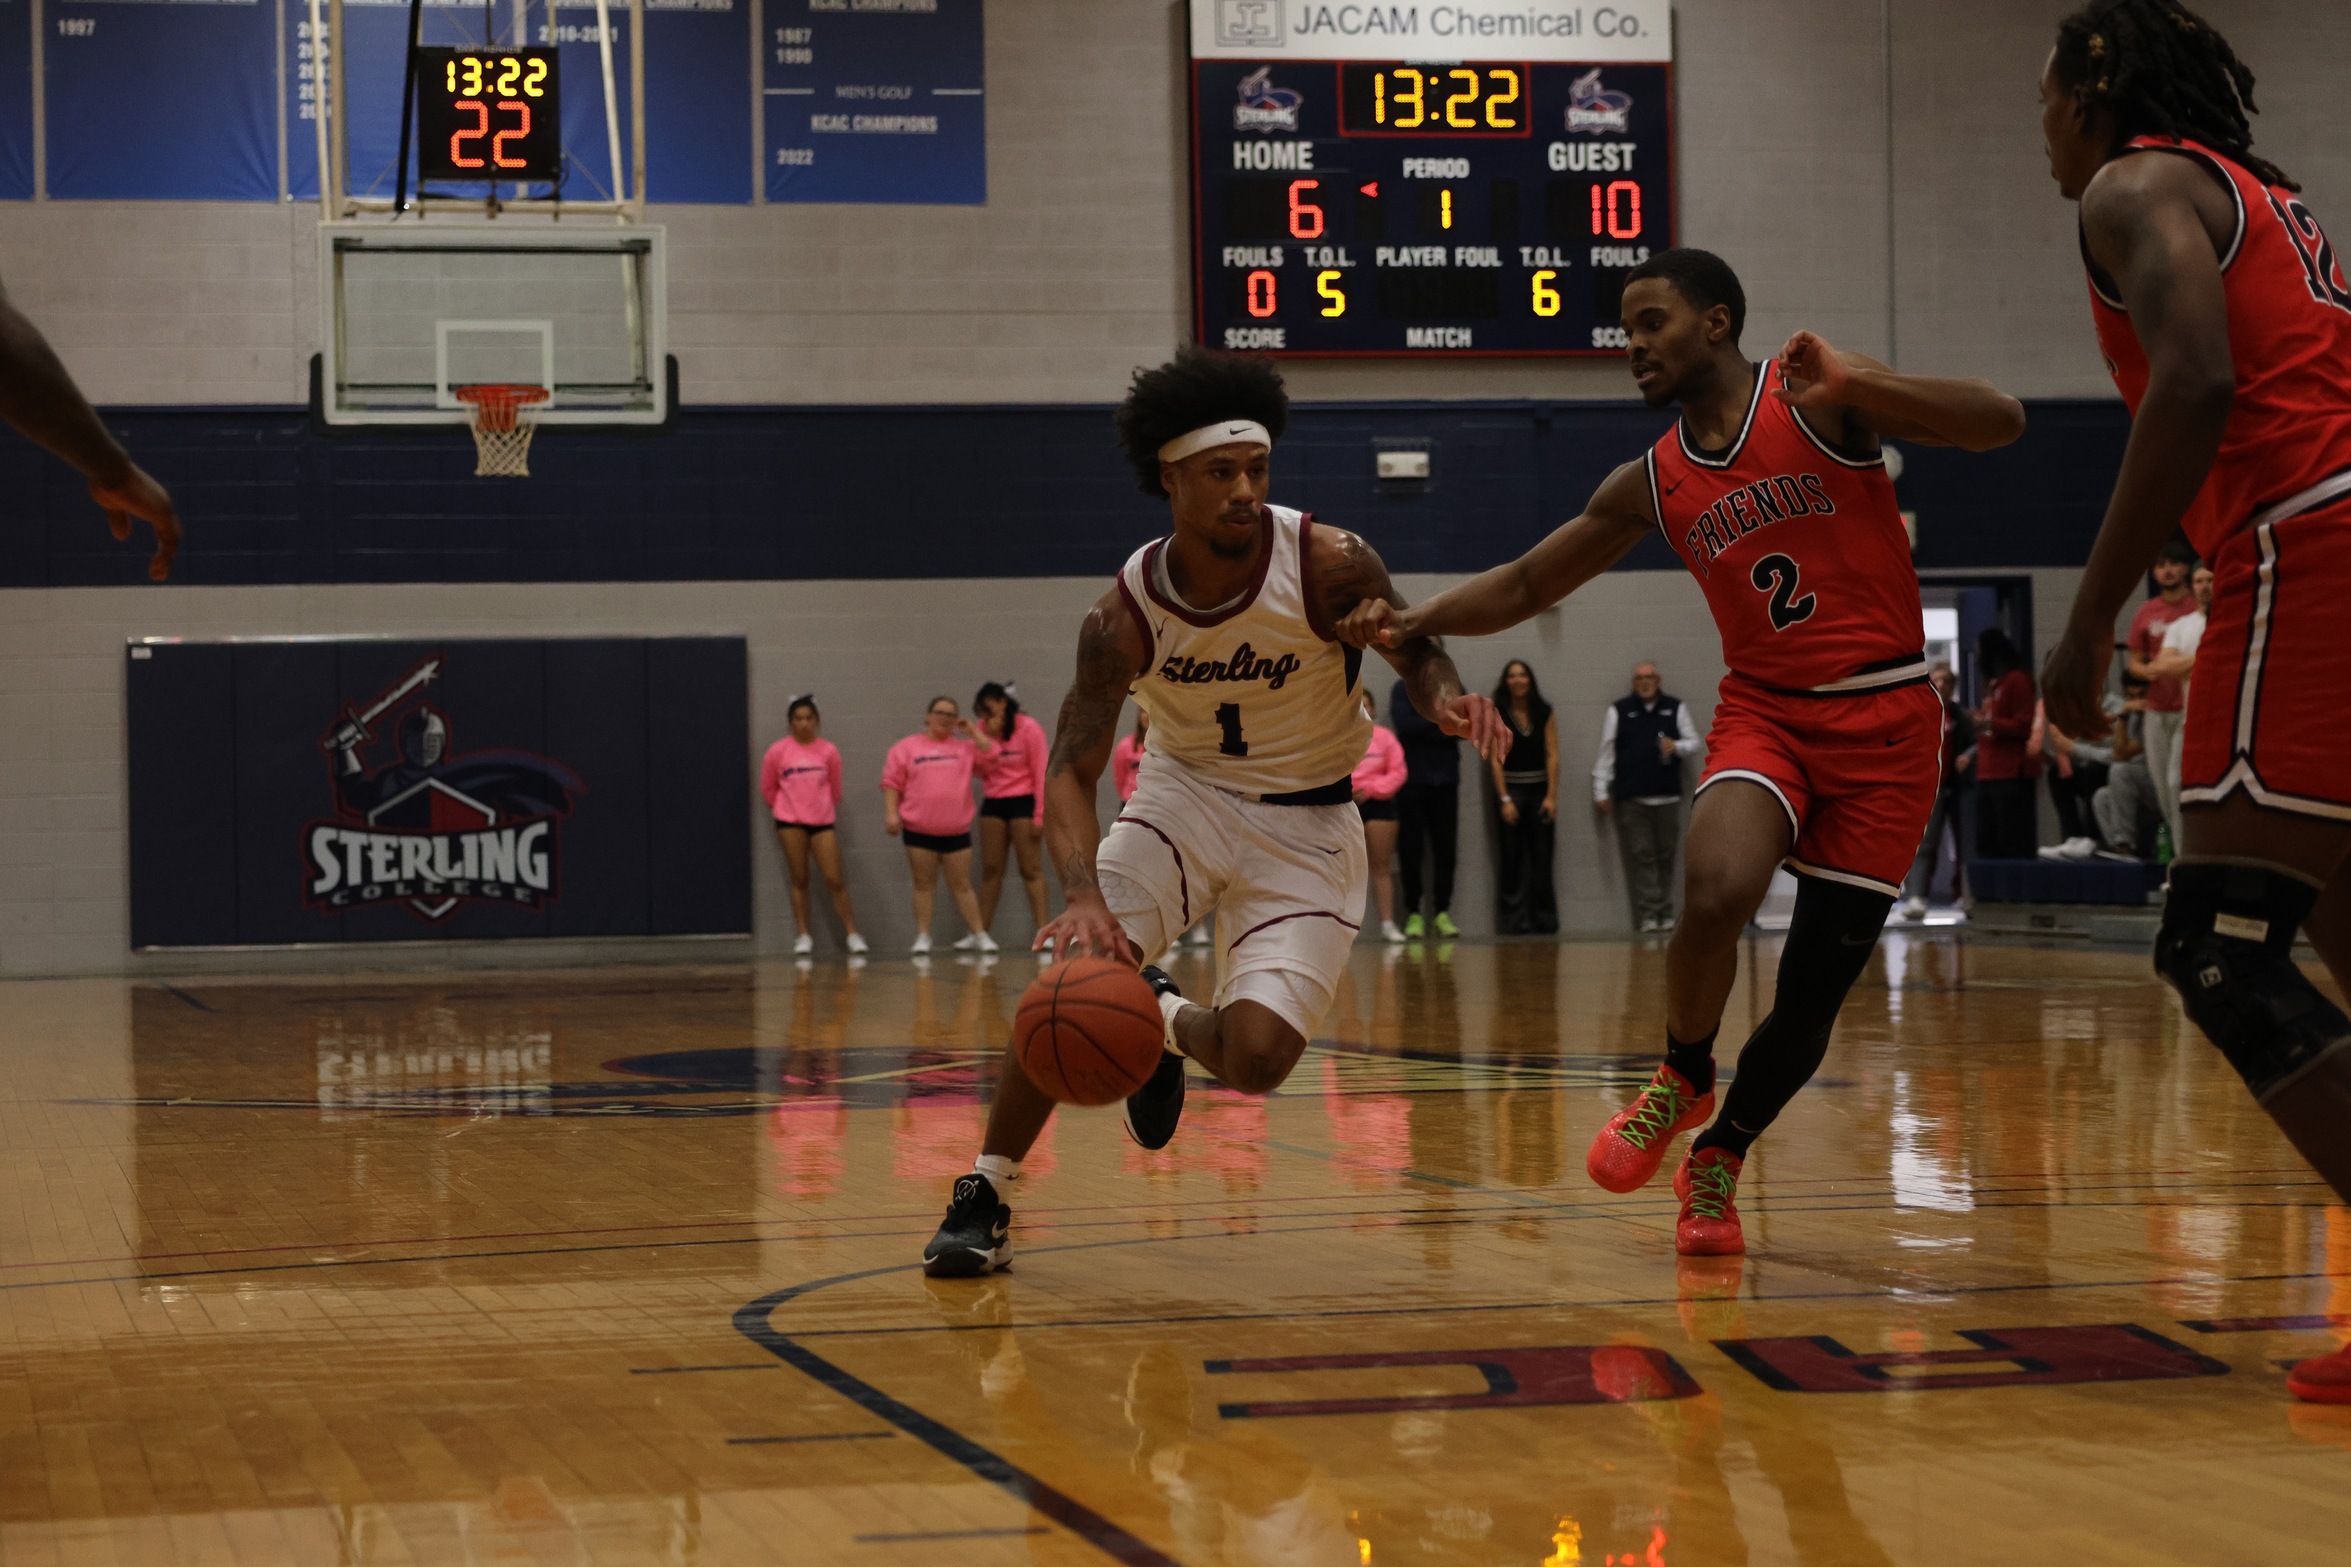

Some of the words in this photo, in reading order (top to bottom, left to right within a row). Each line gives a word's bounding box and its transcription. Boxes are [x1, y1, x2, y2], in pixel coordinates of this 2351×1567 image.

[1294, 5, 1418, 35] JACAM
[1430, 6, 1582, 36] Chemical
[1593, 7, 1648, 38] Co.
[447, 57, 547, 97] 13:22
[878, 86, 913, 99] GOLF
[1374, 68, 1519, 128] 13:22
[450, 100, 531, 168] 22
[811, 114, 849, 131] KCAC
[852, 115, 938, 133] CHAMPIONS
[1233, 141, 1313, 170] HOME
[1403, 158, 1470, 179] PERIOD
[1548, 142, 1637, 172] GUEST
[1288, 180, 1324, 239] 6
[1440, 189, 1451, 230] 1
[1591, 180, 1642, 239] 10
[1223, 246, 1284, 267] FOULS
[1305, 247, 1356, 267] T.O.L.
[1376, 247, 1446, 267] PLAYER
[1455, 247, 1502, 267] FOUL
[1519, 247, 1571, 267] T.O.L.
[1590, 246, 1650, 267] FOULS
[2261, 185, 2351, 316] 12
[1247, 271, 1277, 318] 0
[1316, 271, 1346, 318] 5
[1532, 271, 1561, 317] 6
[1225, 329, 1285, 349] SCORE
[1406, 329, 1471, 349] MATCH
[1591, 326, 1630, 348] SCO
[1685, 473, 1835, 580] FRIENDS
[1750, 552, 1817, 633] 2
[1158, 642, 1301, 690] Sterling
[1214, 703, 1249, 757] 1
[311, 821, 549, 894] STERLING
[331, 880, 534, 905] COLLEGE
